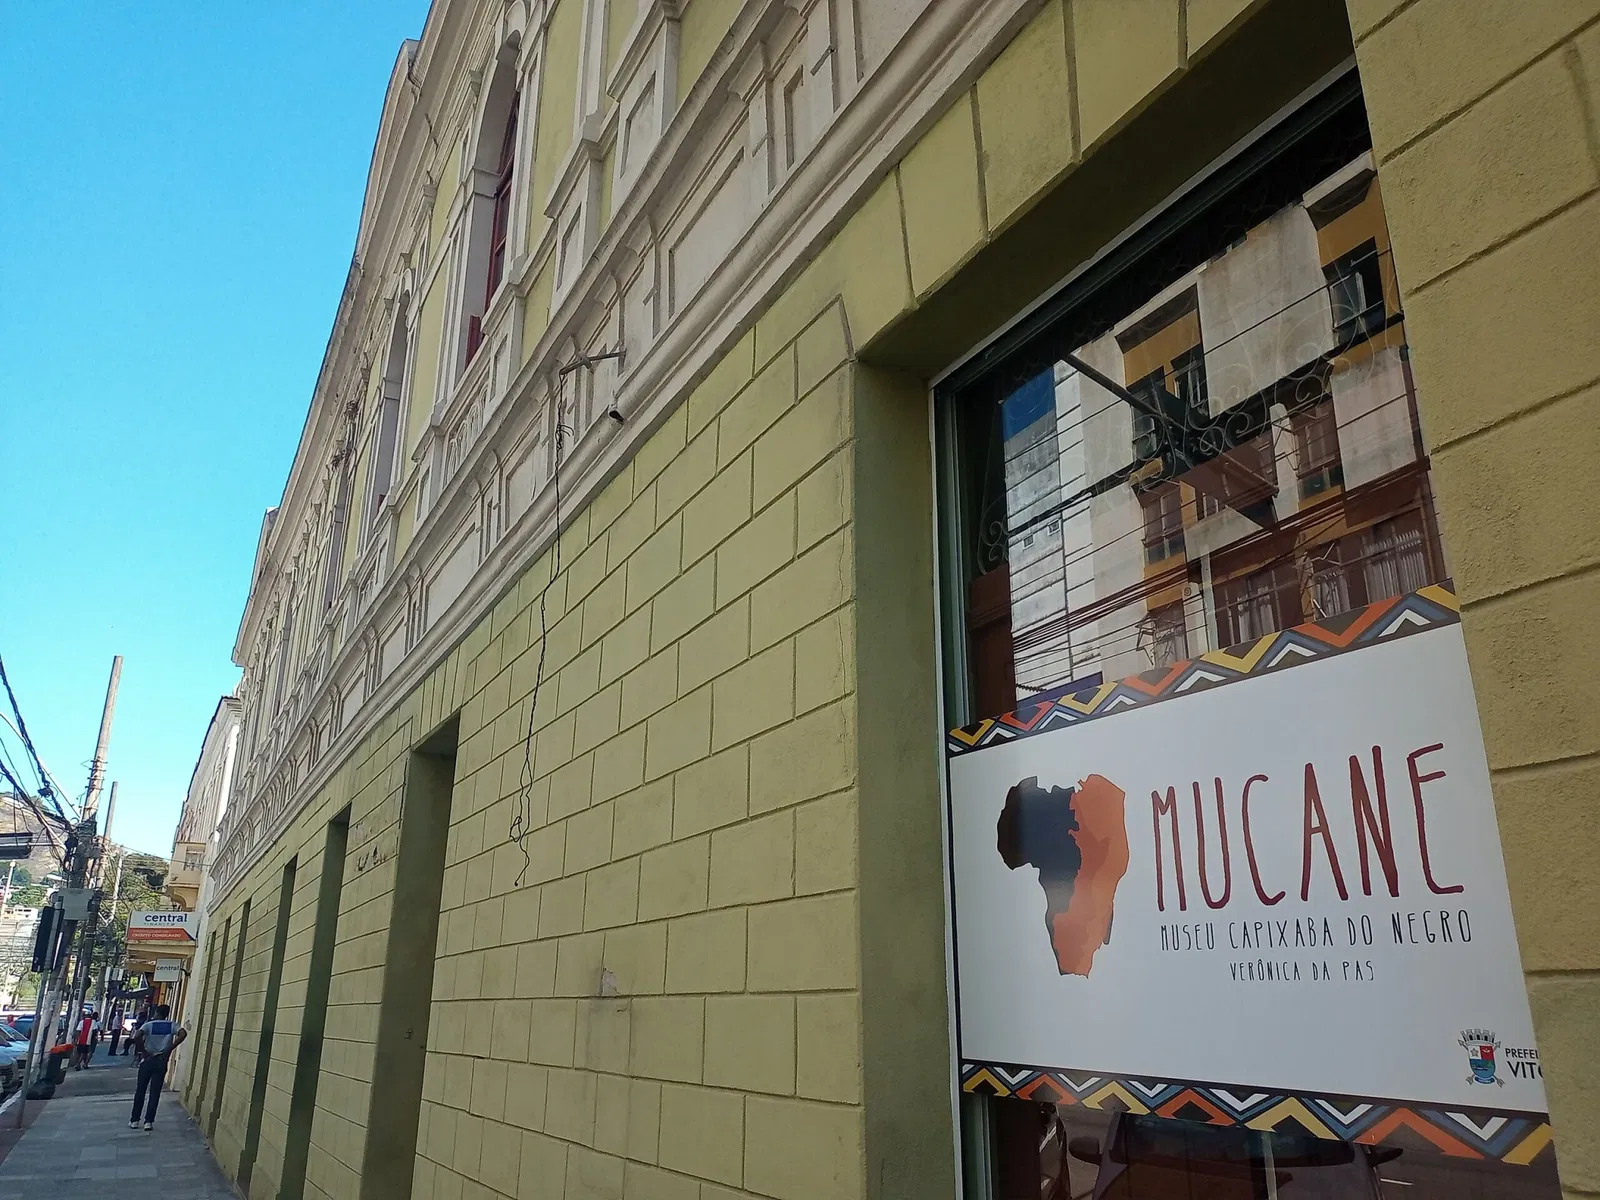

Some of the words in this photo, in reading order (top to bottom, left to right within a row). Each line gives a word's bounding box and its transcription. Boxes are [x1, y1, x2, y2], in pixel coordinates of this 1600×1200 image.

[1150, 742, 1465, 913] MUCANE
[145, 913, 188, 922] central
[1160, 922, 1215, 951] MUSEU
[1228, 916, 1334, 950] CAPIXABA
[1346, 914, 1373, 946] DO
[1391, 909, 1472, 945] NEGRO
[1229, 958, 1301, 982] VERÔNICA
[1311, 960, 1331, 981] DA
[1342, 960, 1374, 981] PAS
